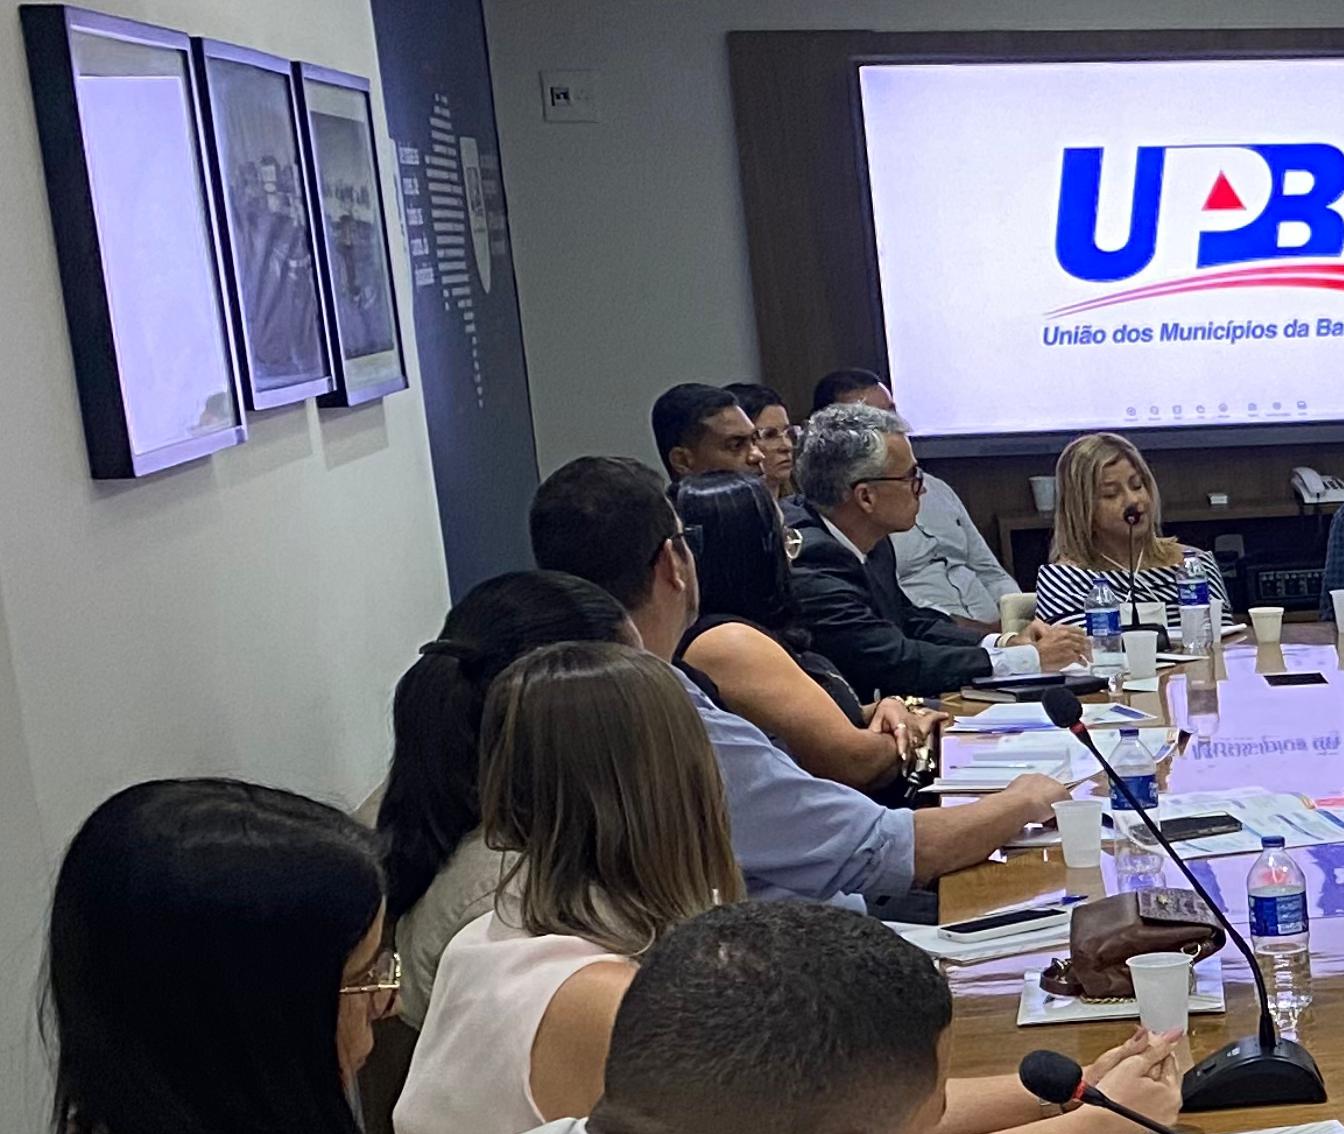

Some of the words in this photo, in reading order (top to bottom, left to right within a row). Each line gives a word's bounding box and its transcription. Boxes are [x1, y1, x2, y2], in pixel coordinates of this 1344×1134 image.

[1043, 324, 1106, 346] União
[1113, 322, 1153, 344] dos
[1159, 320, 1278, 345] Municípios
[1283, 319, 1309, 338] da
